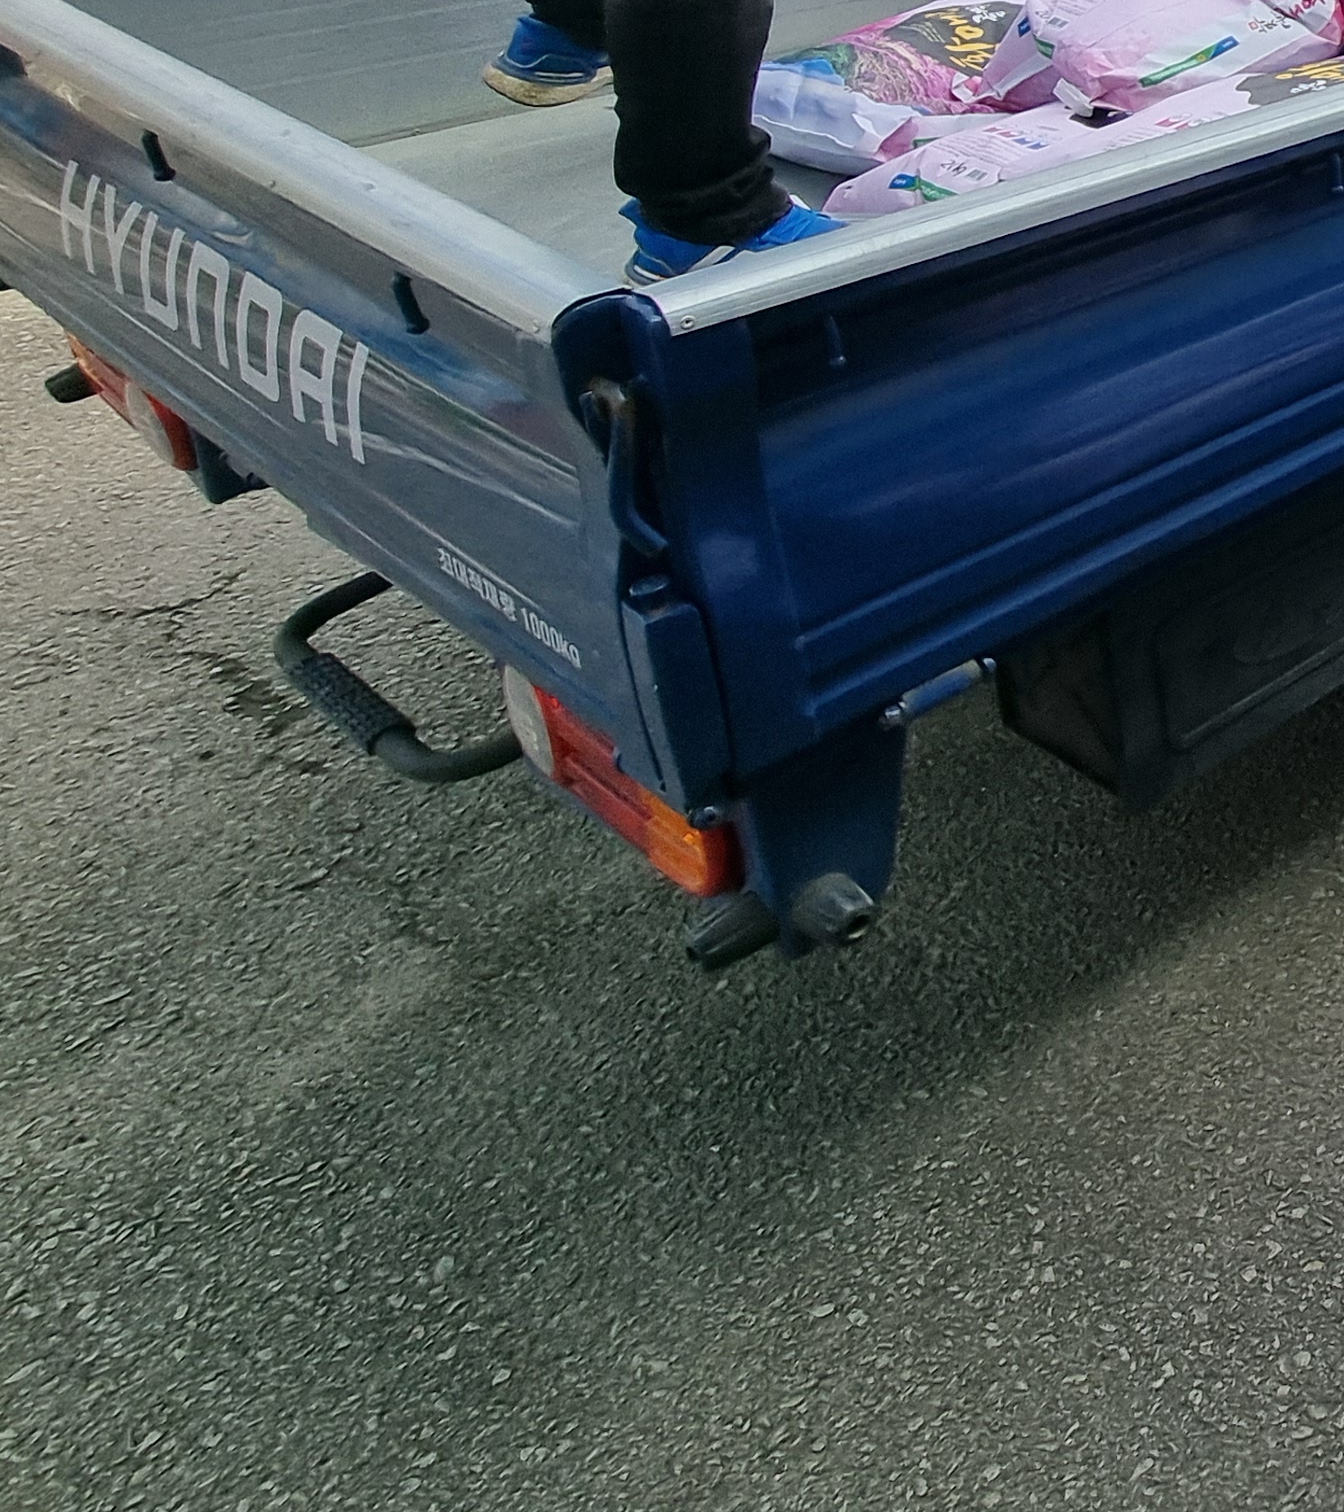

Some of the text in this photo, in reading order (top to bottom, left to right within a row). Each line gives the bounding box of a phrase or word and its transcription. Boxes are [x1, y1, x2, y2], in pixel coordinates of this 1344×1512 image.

[58, 160, 370, 465] HYUNDAI
[437, 546, 583, 670] 최대적재량 1000kg
